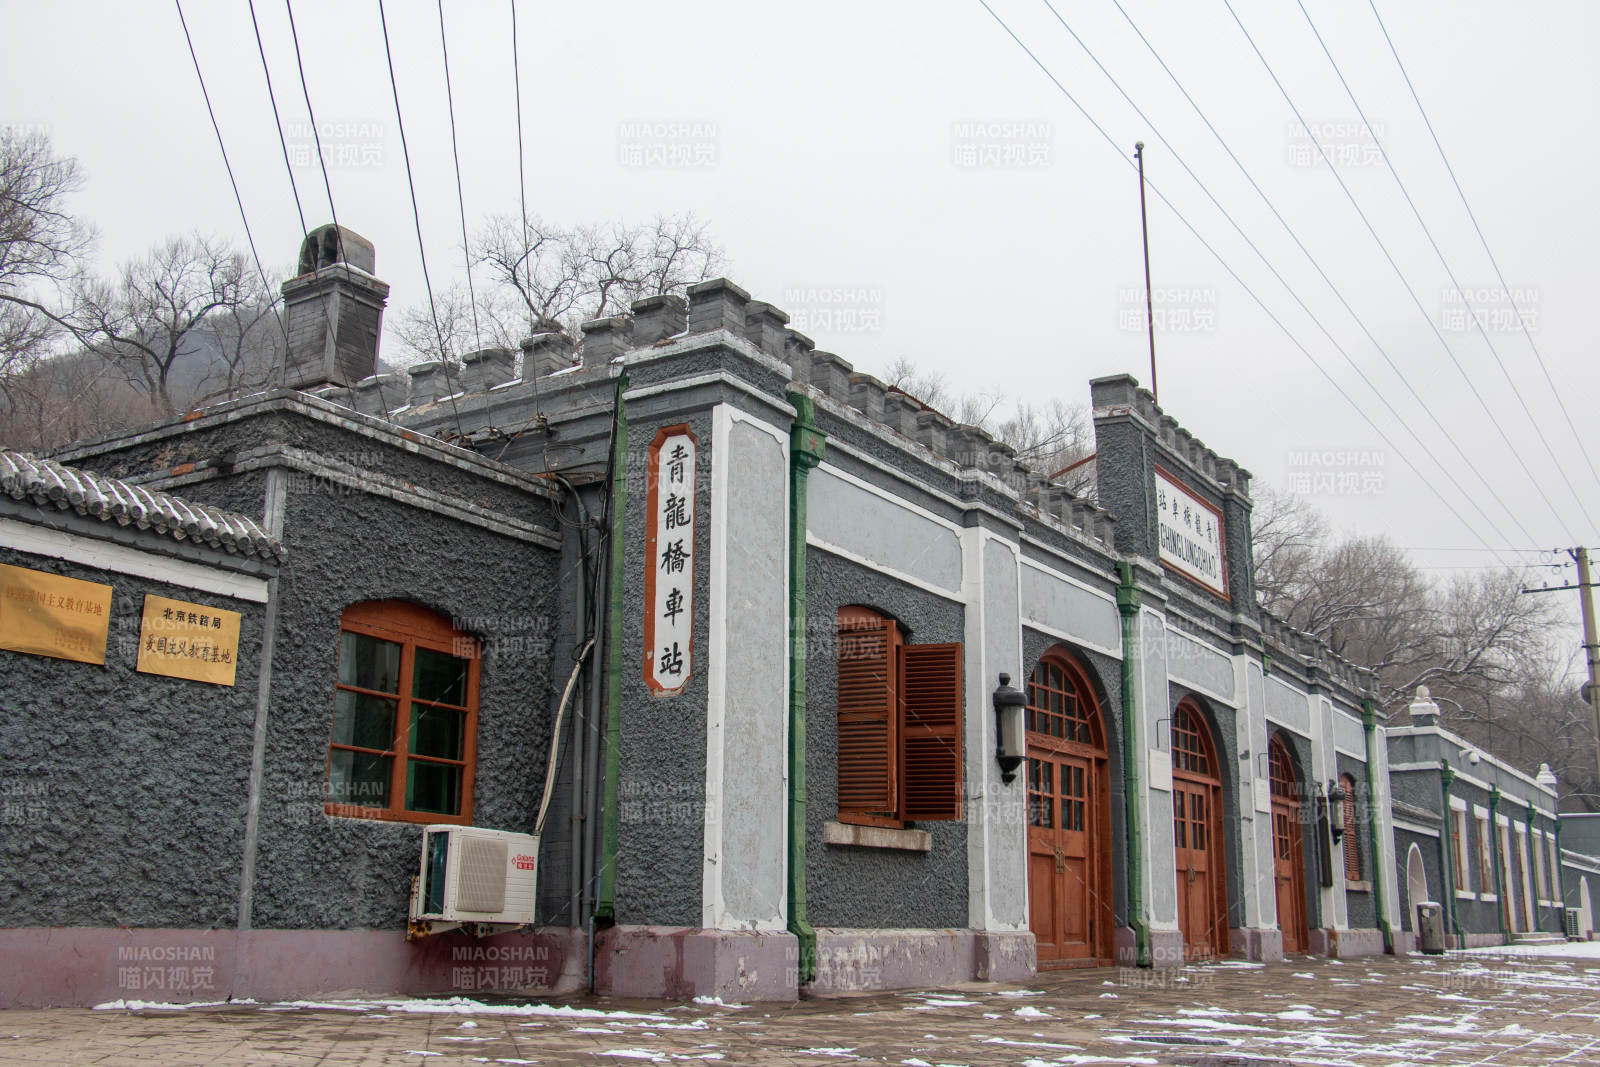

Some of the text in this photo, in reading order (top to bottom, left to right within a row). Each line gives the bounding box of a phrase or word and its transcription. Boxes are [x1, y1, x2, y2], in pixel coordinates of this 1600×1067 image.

[659, 444, 691, 677] 青龍橋車站
[163, 607, 222, 629] 北京铁路局
[145, 633, 232, 664] 爱国主义教育基地
